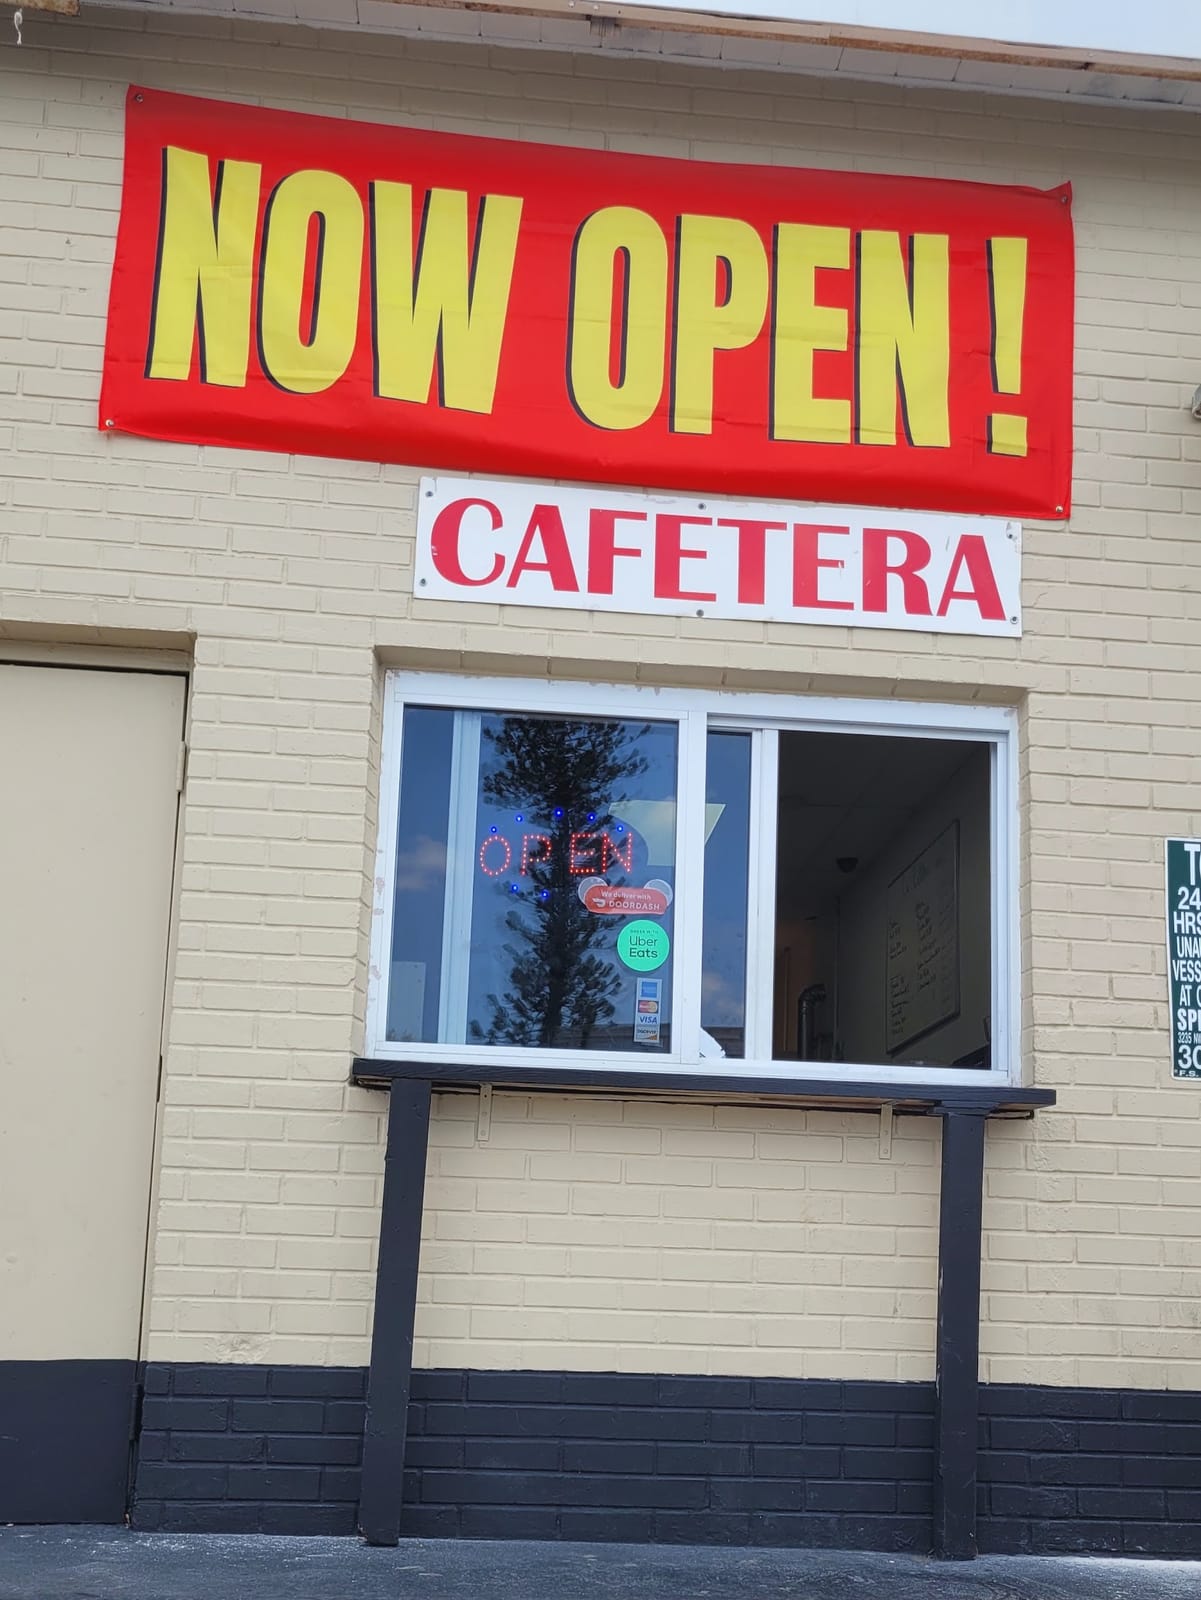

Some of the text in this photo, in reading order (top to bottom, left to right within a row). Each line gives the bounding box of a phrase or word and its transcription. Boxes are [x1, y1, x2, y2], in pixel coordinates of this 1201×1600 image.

[145, 145, 523, 415] NOW
[567, 206, 949, 449] OPEN
[430, 497, 1007, 621] CAFETERA
[479, 831, 634, 876] OPEN
[1184, 843, 1201, 886] T
[608, 900, 660, 910] DOORDASH
[1178, 886, 1201, 911] 24
[629, 935, 658, 947] Uber
[629, 947, 658, 958] Eats
[1176, 936, 1201, 959] UNA
[1180, 984, 1192, 1006] AT
[639, 1015, 658, 1024] VISA
